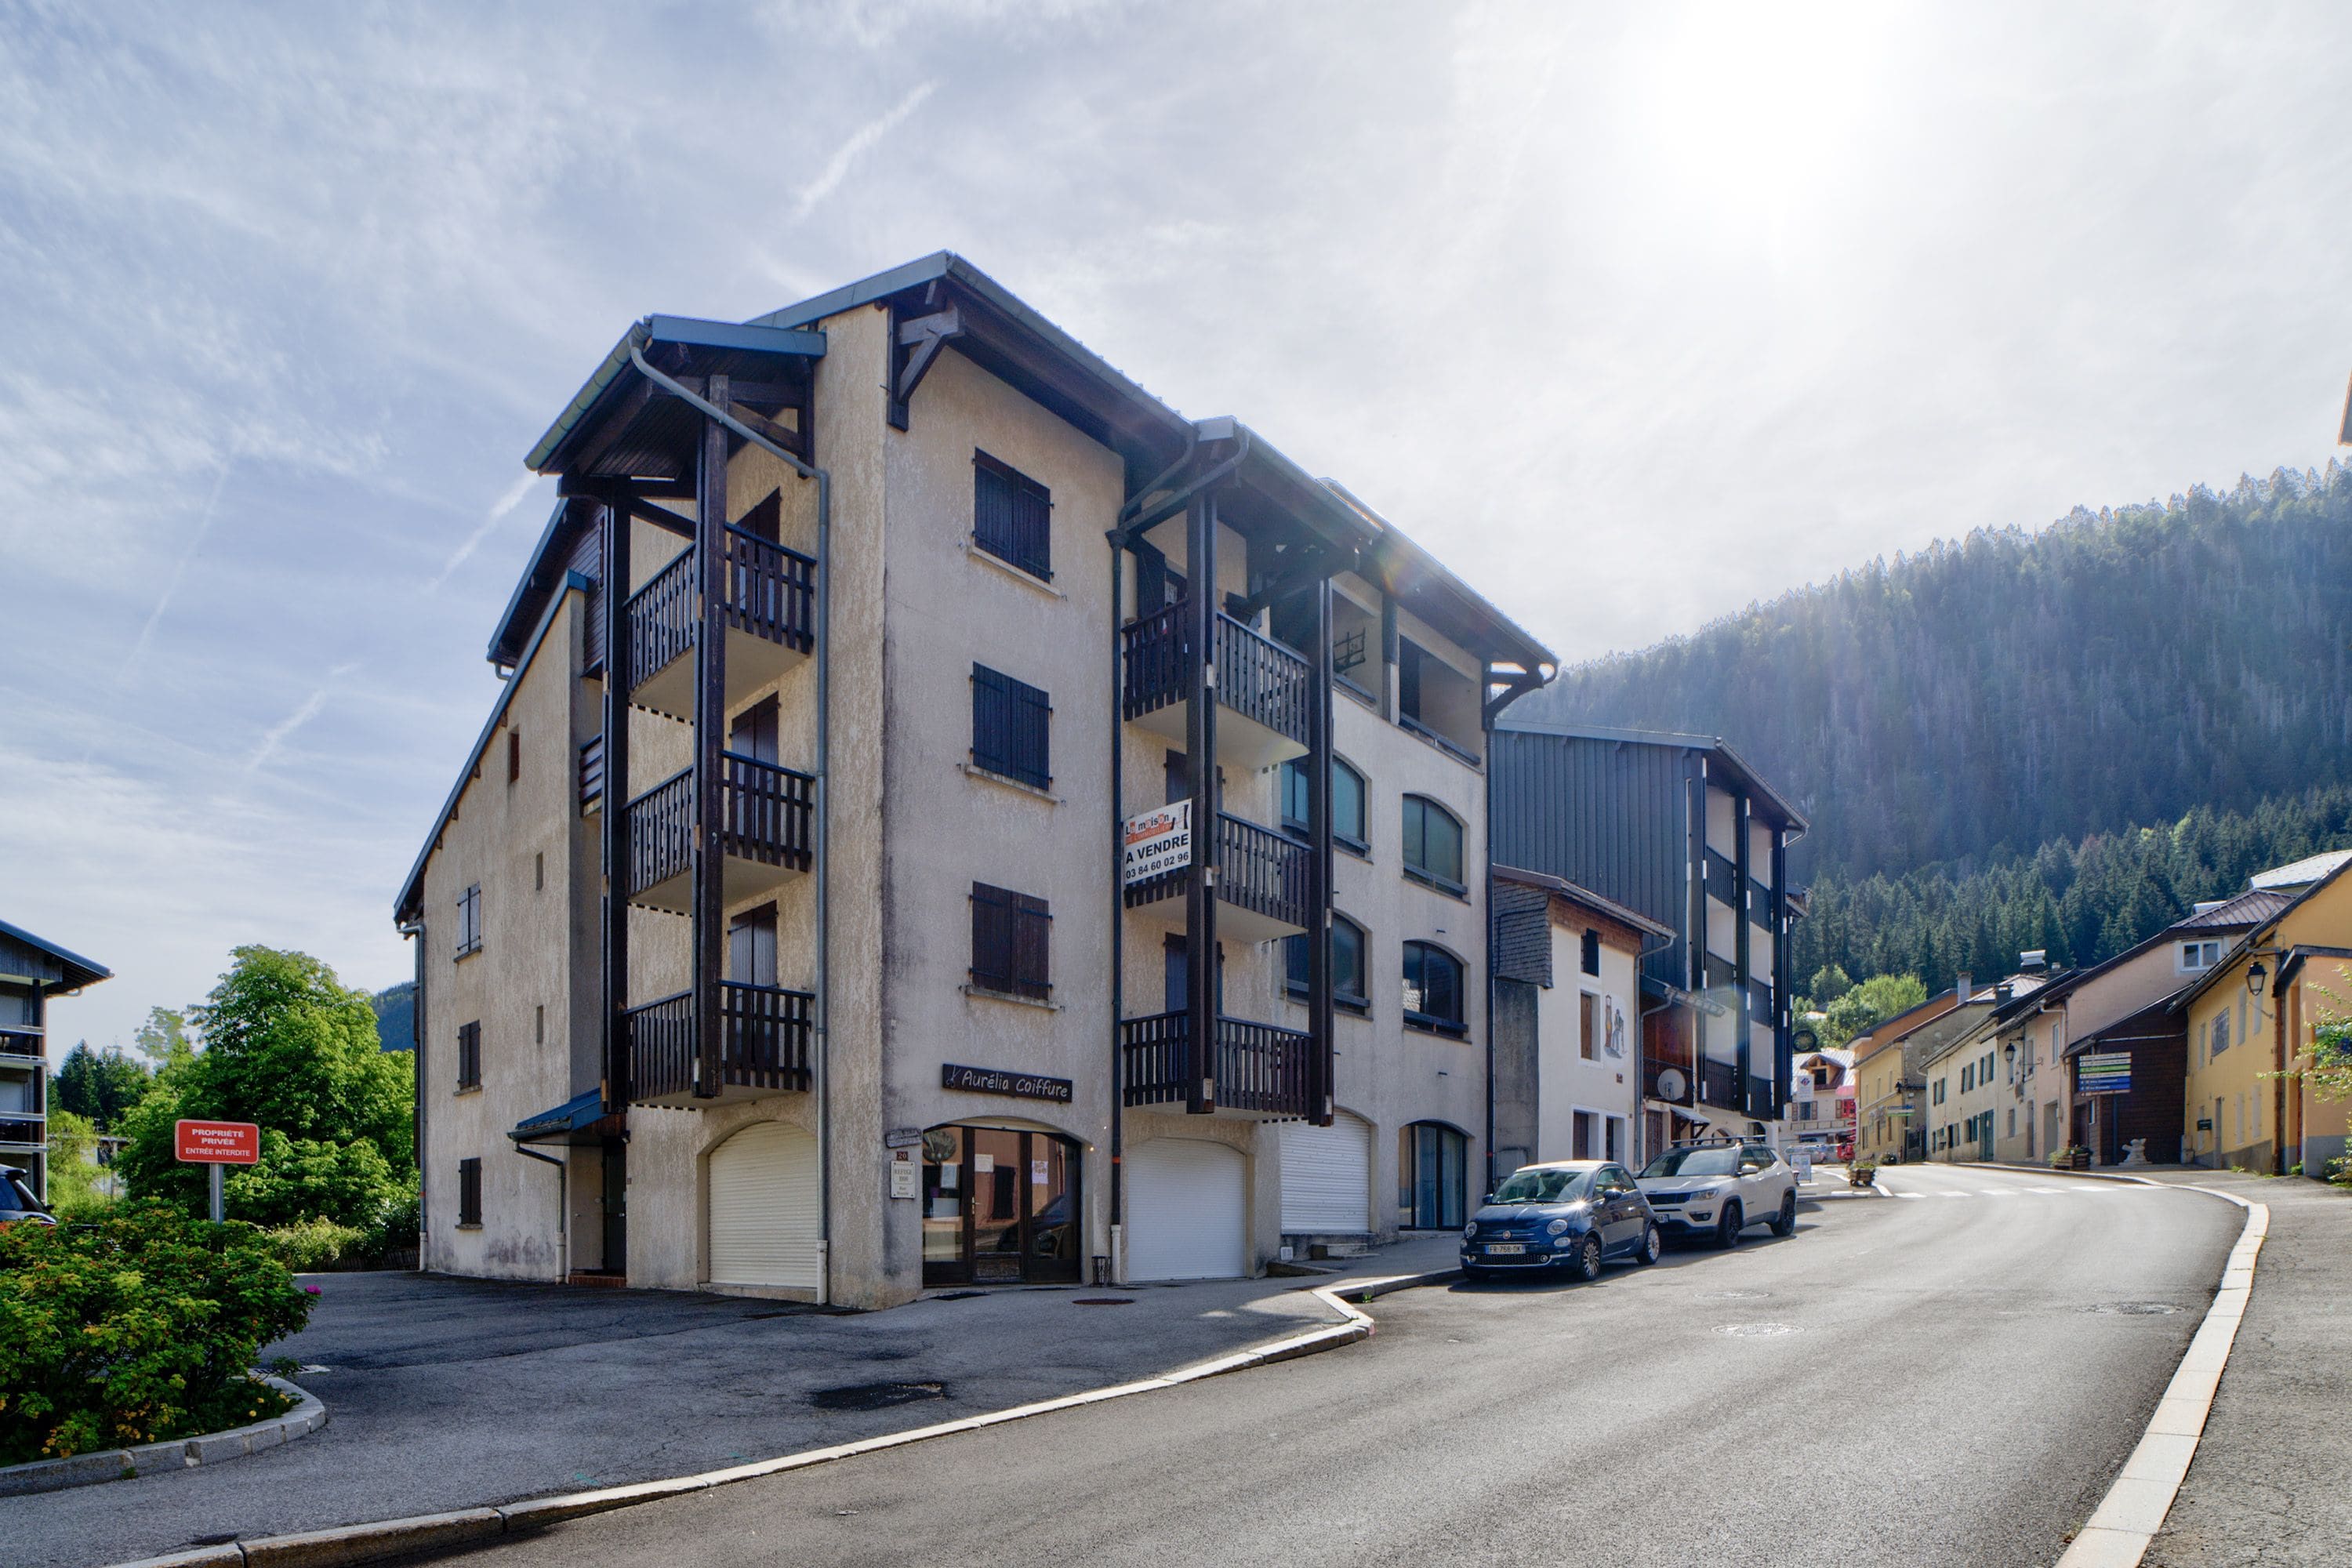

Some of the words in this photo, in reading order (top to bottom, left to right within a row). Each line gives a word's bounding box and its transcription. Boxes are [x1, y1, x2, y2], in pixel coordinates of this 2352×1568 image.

[1126, 851, 1134, 864] A
[1137, 833, 1189, 859] VENDRE
[1126, 868, 1136, 879] 03
[1138, 864, 1149, 875] 84
[1151, 859, 1161, 871] 60
[1163, 856, 1175, 867] 02
[1178, 851, 1189, 862] 96
[962, 1070, 1009, 1091] Aurélia
[1016, 1078, 1069, 1098] Coiffure
[192, 1128, 245, 1138] PROPRIÉTÉ
